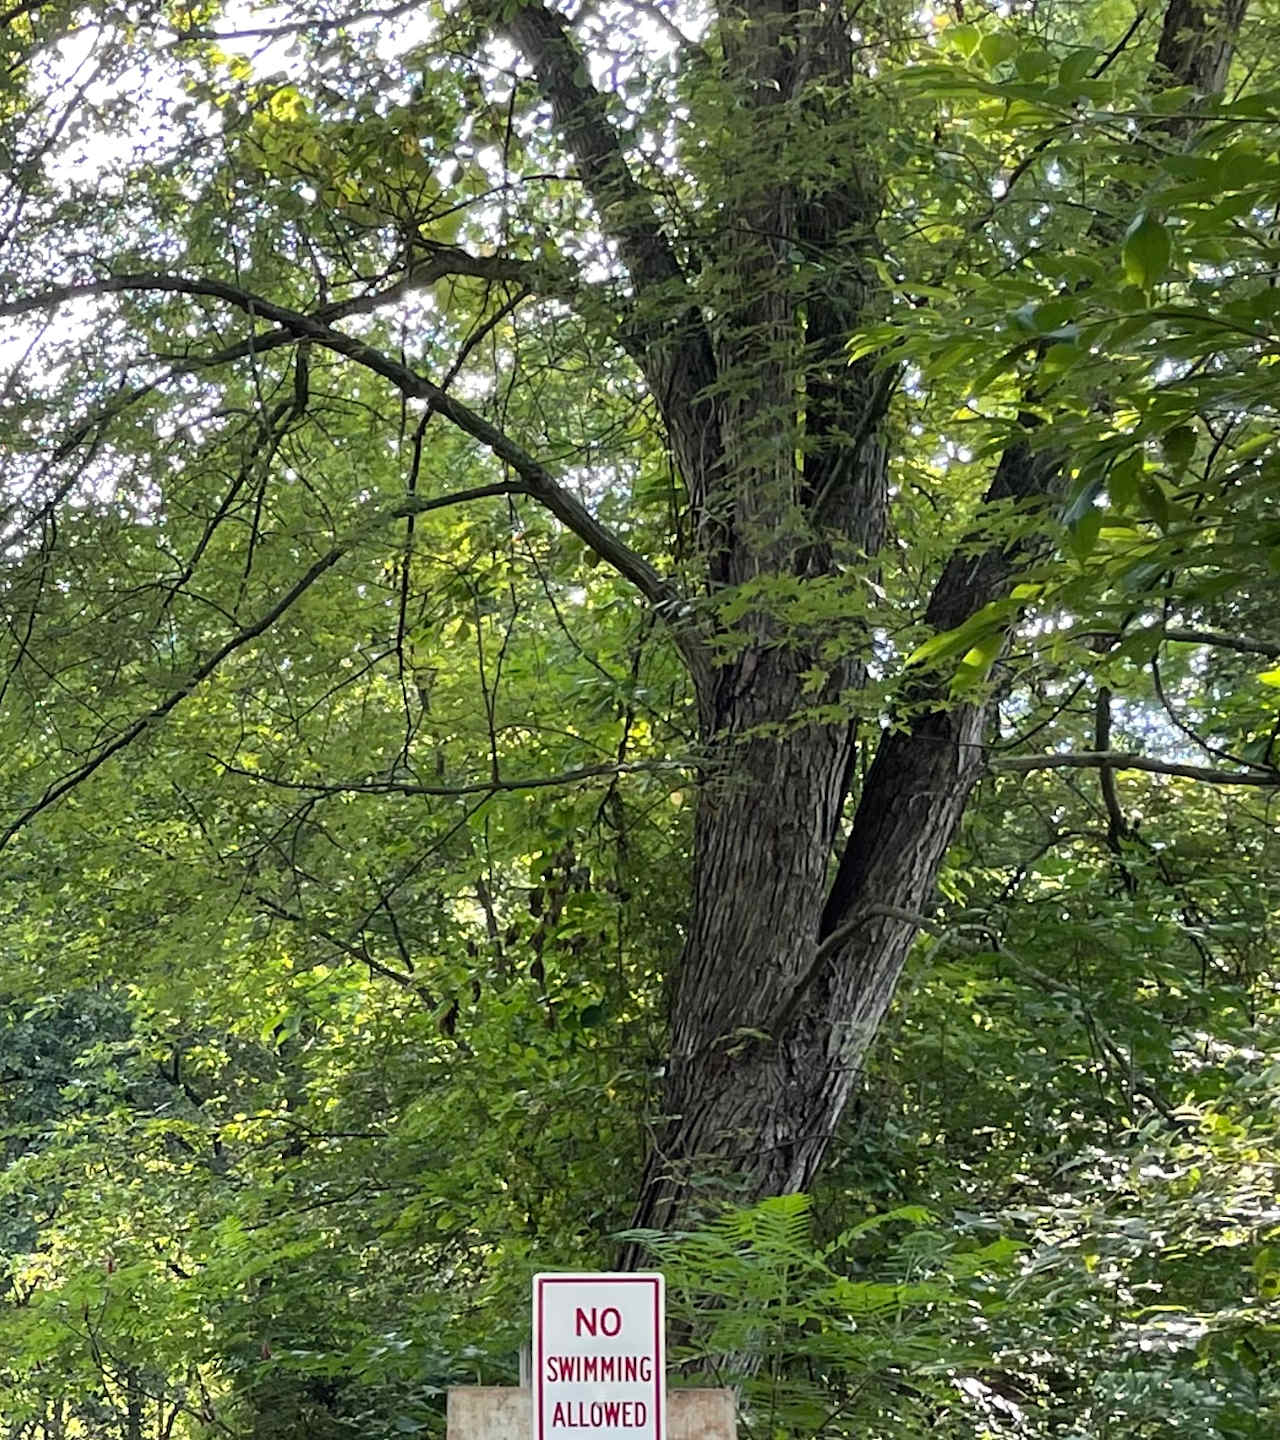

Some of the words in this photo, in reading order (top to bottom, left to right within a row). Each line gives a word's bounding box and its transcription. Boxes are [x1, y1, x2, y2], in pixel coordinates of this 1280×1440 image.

[576, 1308, 622, 1336] NO
[547, 1356, 652, 1382] SWIMMING
[553, 1402, 646, 1427] ALLOWED
